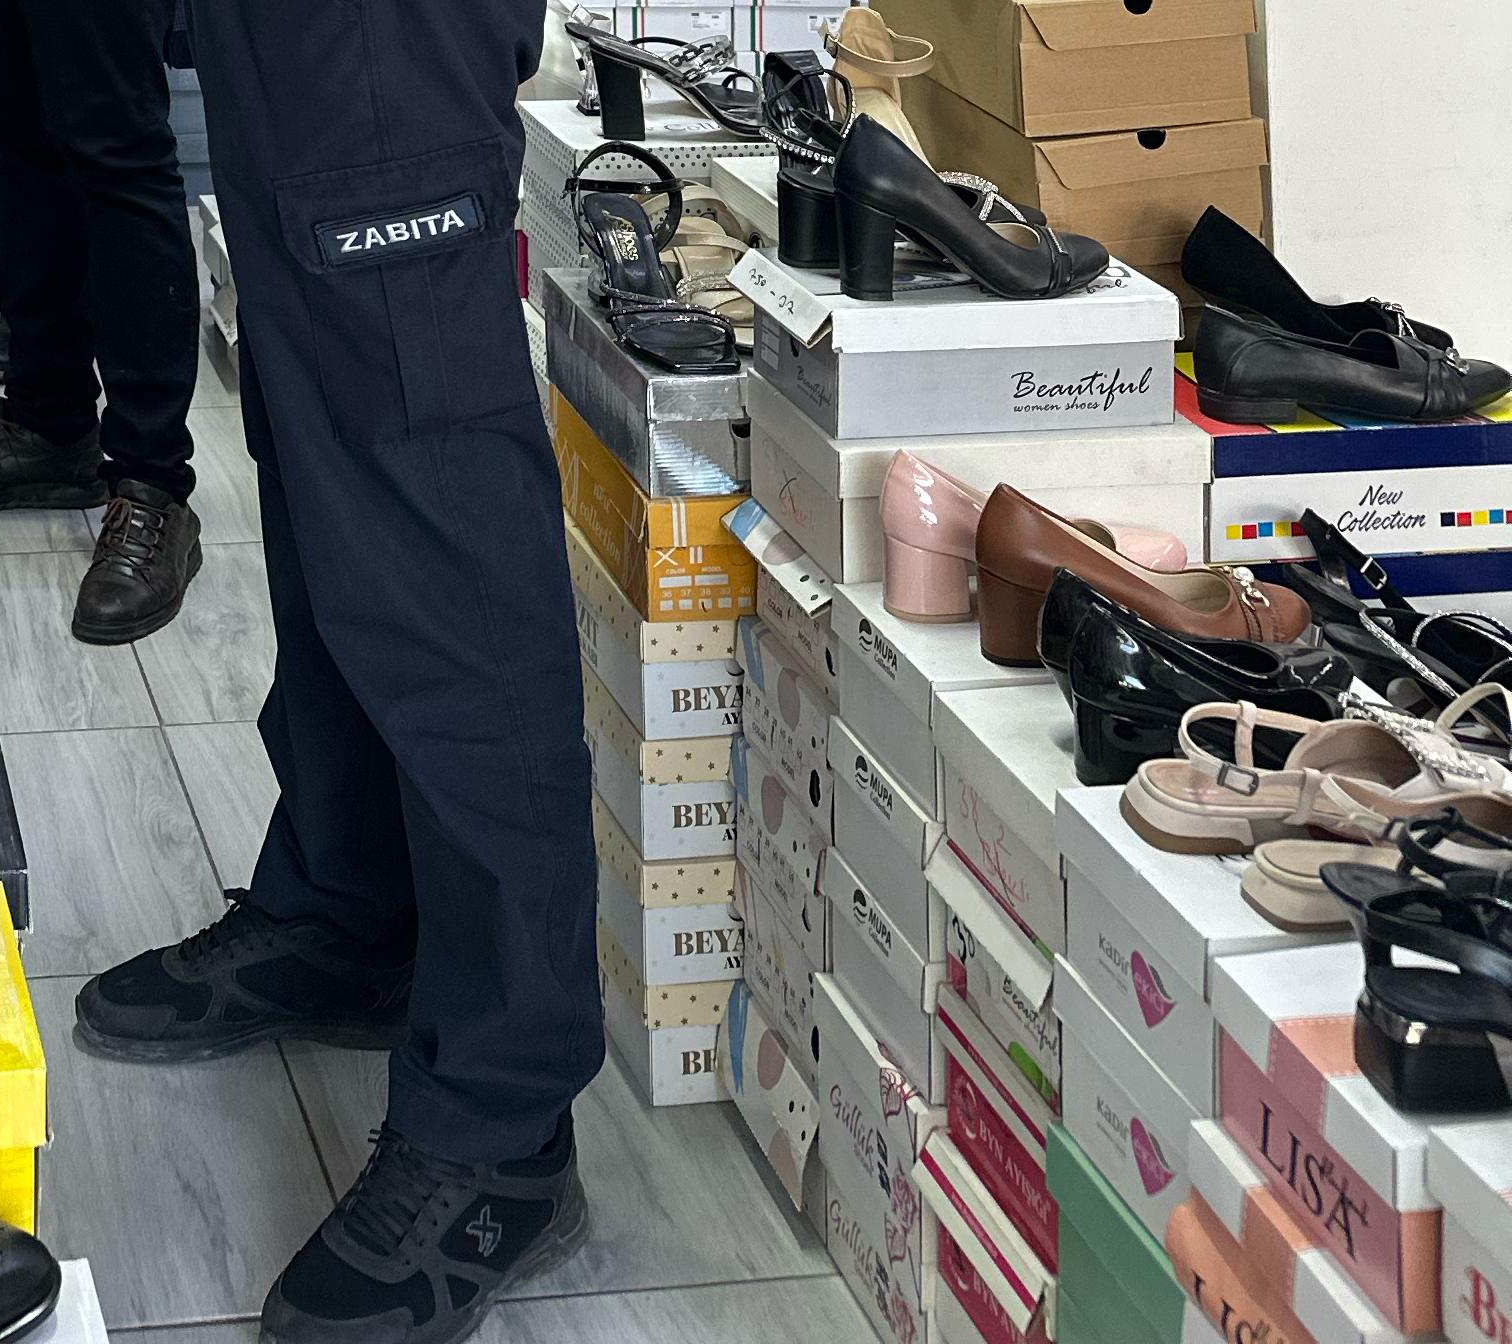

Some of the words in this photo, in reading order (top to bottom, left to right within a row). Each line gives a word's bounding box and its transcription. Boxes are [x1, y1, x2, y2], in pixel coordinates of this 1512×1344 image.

[336, 209, 465, 254] ZABITA
[1010, 367, 1153, 409] Beautiful
[1013, 402, 1062, 413] women
[1066, 400, 1100, 412] shoes
[1359, 486, 1404, 507] New
[1337, 510, 1426, 533] Collection
[874, 634, 898, 671] MUPA
[870, 772, 893, 811] MUPA
[868, 907, 892, 953] MUPA
[1258, 1098, 1358, 1260] LISA
